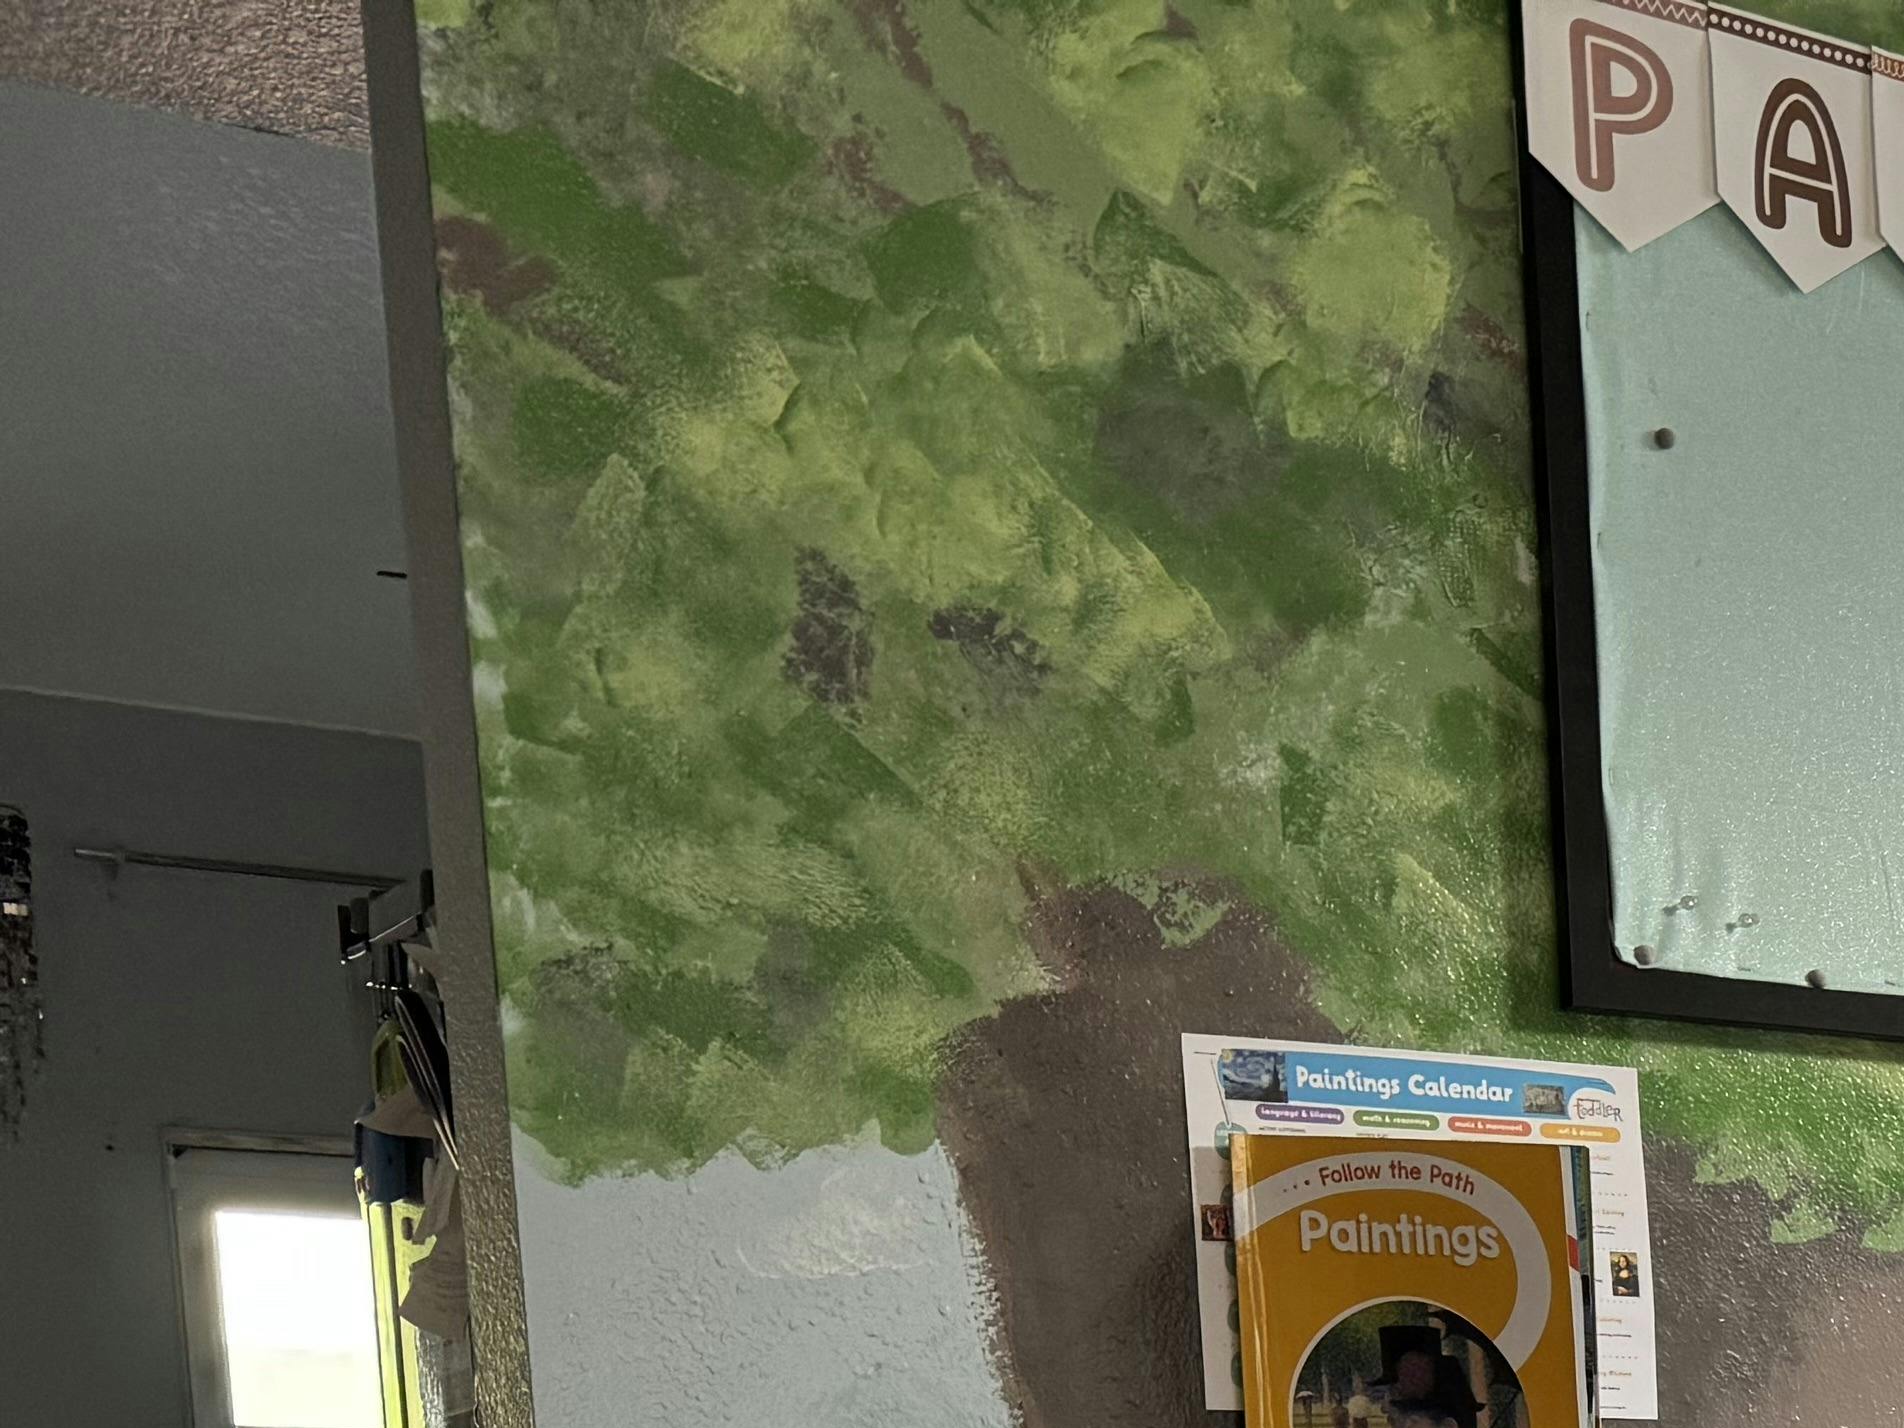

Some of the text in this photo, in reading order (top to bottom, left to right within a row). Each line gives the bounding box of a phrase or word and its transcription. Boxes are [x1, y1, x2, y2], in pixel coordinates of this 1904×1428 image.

[1296, 1065, 1512, 1102] Paintings Calendar
[1319, 1160, 1474, 1195] Follow the Path
[1300, 1208, 1501, 1267] Paintings
